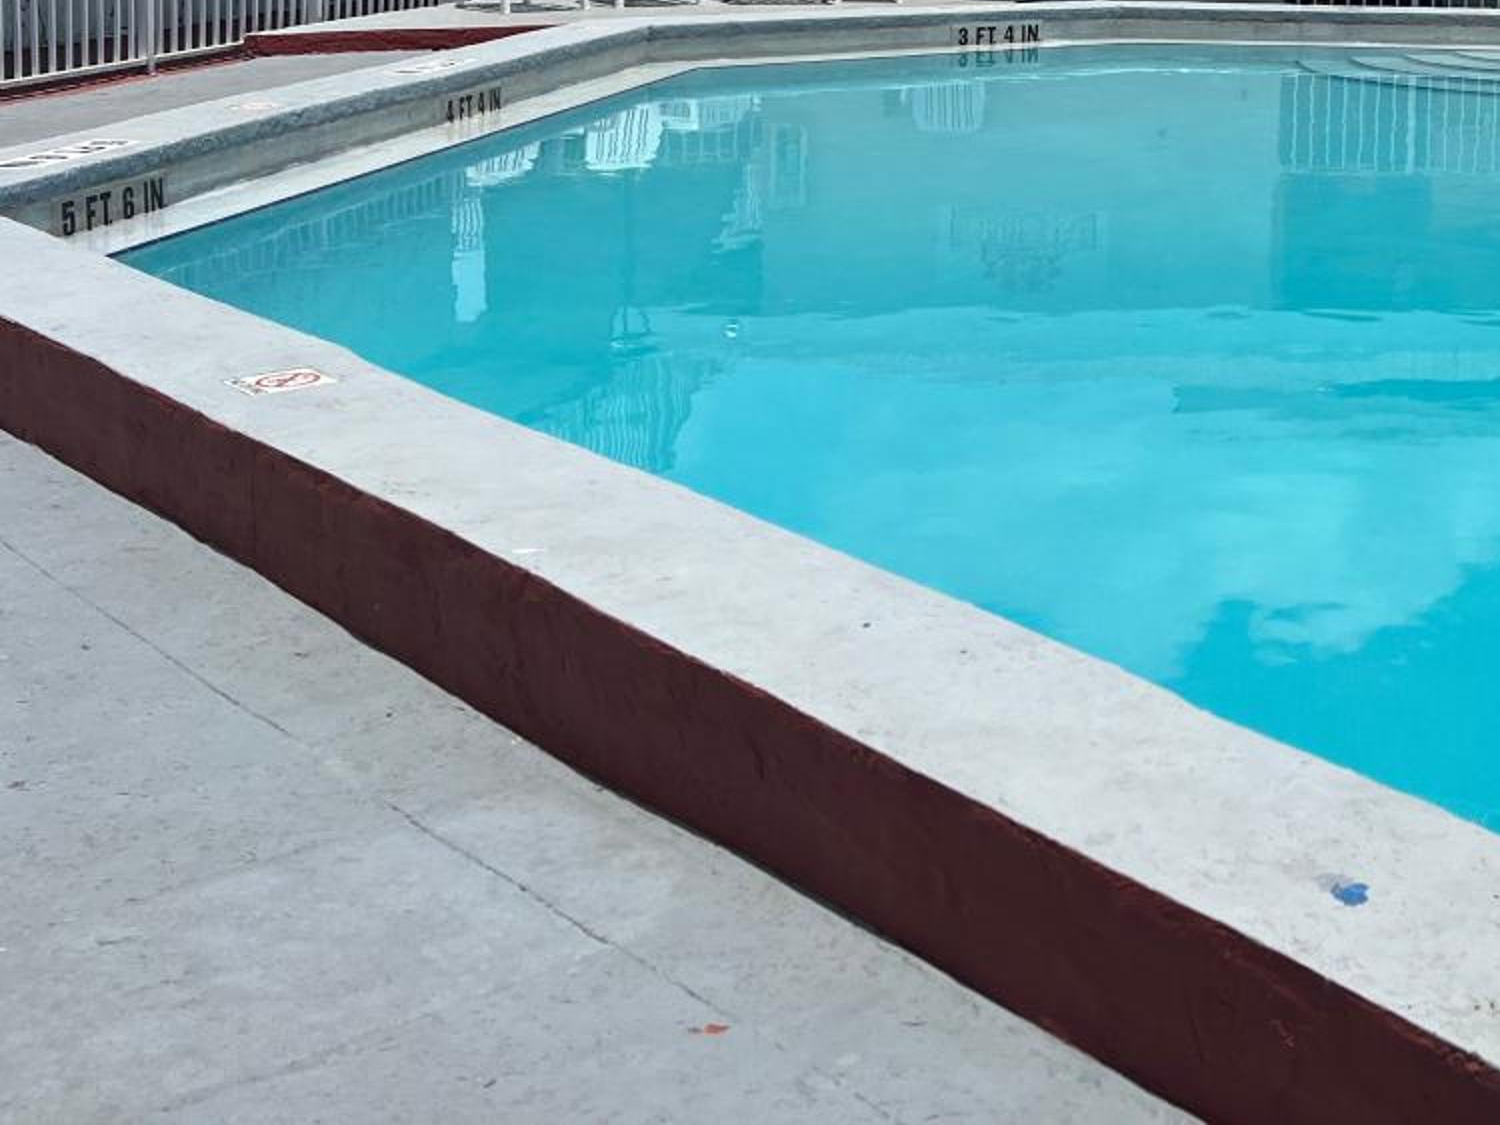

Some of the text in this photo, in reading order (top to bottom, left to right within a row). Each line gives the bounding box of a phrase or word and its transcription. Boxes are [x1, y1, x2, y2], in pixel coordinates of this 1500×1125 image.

[958, 27, 968, 46] 3
[1003, 25, 1014, 43] 4
[61, 200, 76, 236] 5
[123, 186, 135, 219] 6
